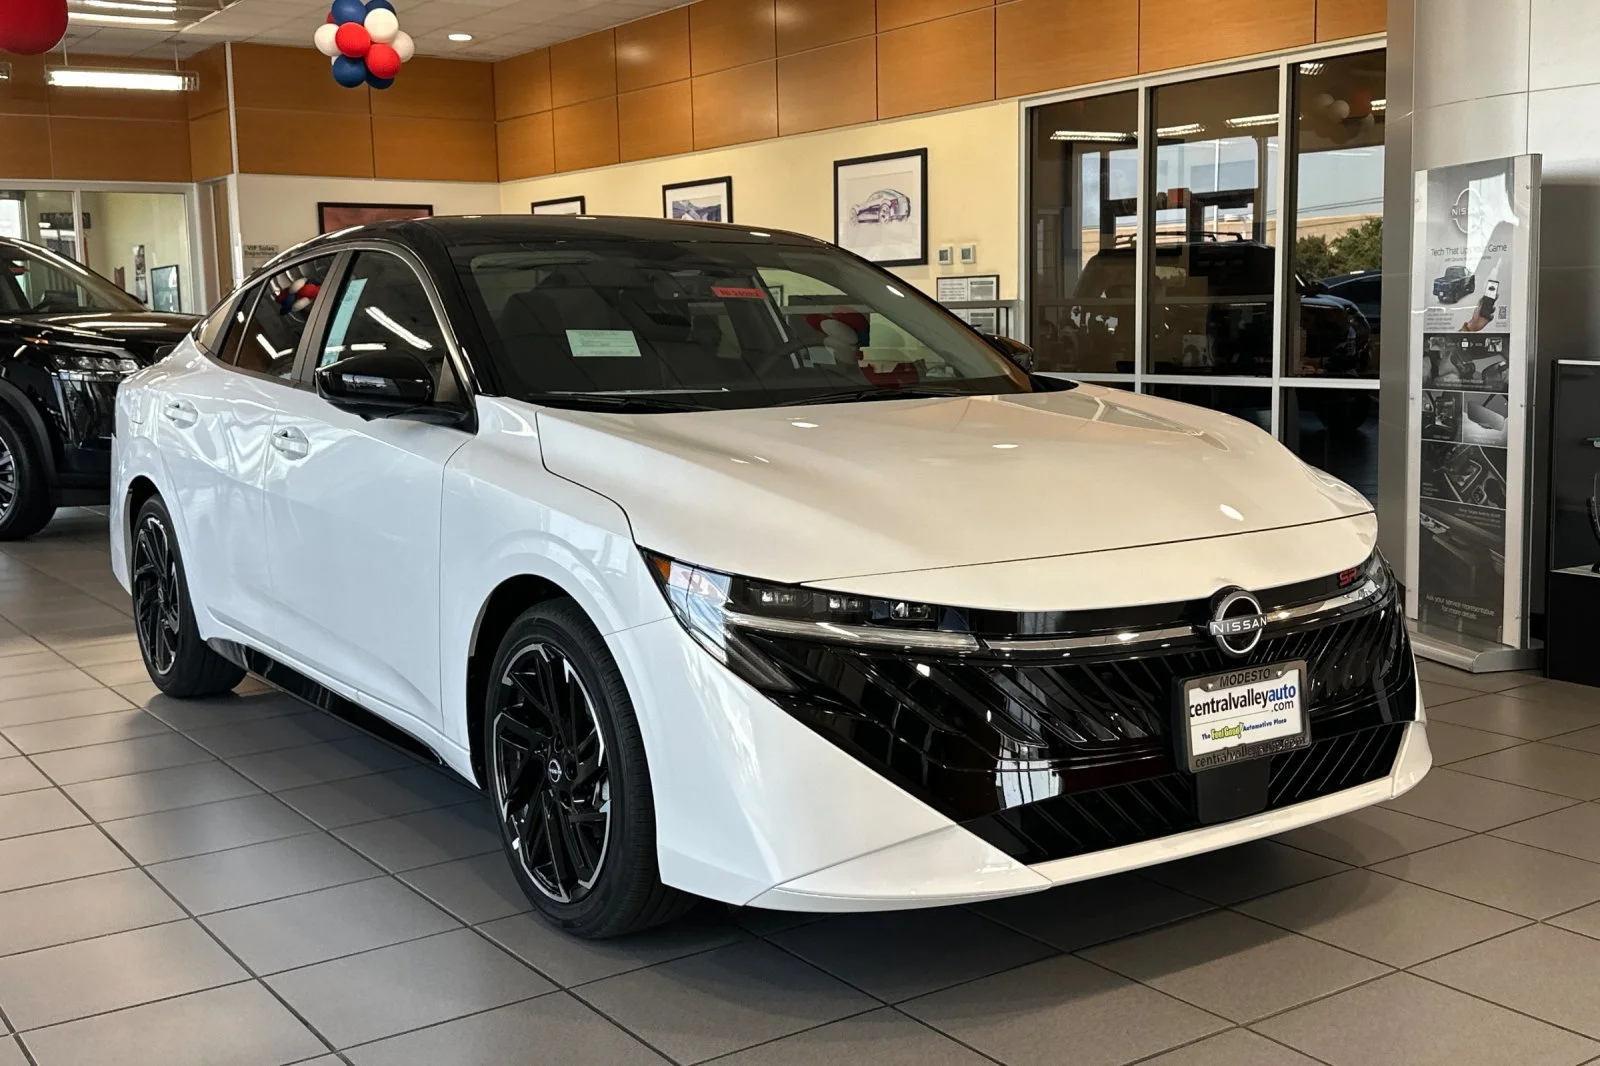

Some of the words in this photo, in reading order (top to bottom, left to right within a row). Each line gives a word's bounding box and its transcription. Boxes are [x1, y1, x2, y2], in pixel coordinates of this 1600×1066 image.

[1431, 248, 1444, 256] Tech
[1446, 247, 1459, 255] That
[1488, 243, 1508, 253] Game
[1213, 616, 1267, 633] NISSAN
[1220, 668, 1271, 687] MODESTO
[1190, 684, 1296, 718] centralvalleyauto
[1271, 700, 1294, 713] .com
[1243, 721, 1273, 732] Automotive
